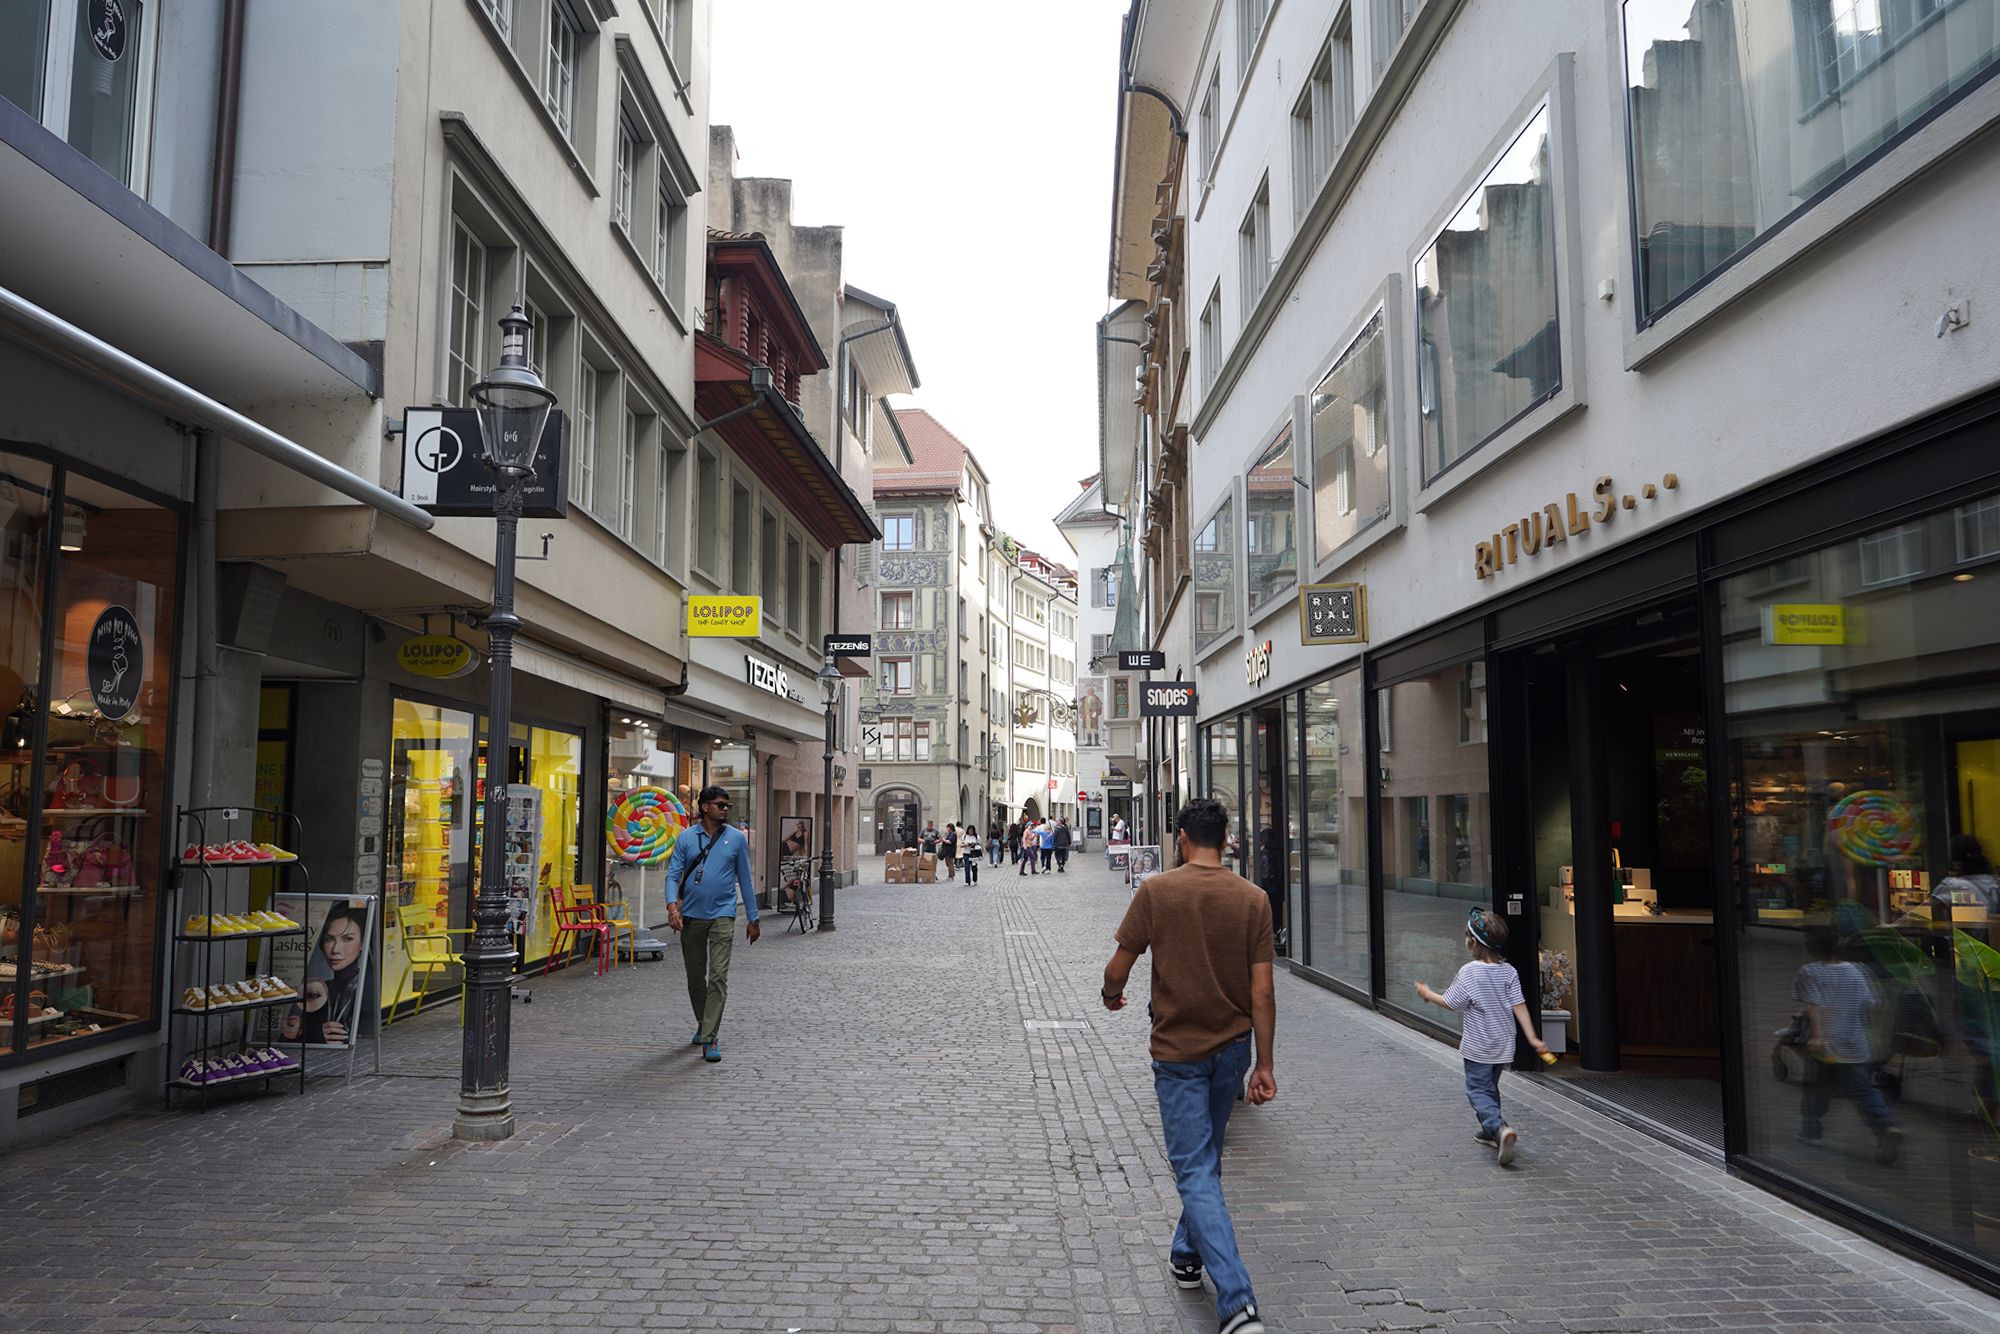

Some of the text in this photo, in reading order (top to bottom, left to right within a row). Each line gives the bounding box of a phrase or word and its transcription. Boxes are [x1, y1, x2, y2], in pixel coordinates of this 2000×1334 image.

[470, 485, 497, 493] Hairstyli
[693, 605, 753, 618] LOLIPOP
[404, 645, 463, 657] LOLIPOP
[1128, 655, 1151, 666] WE
[1245, 644, 1270, 687] snipes
[747, 655, 788, 698] TEZENIS
[1147, 687, 1190, 709] snipes
